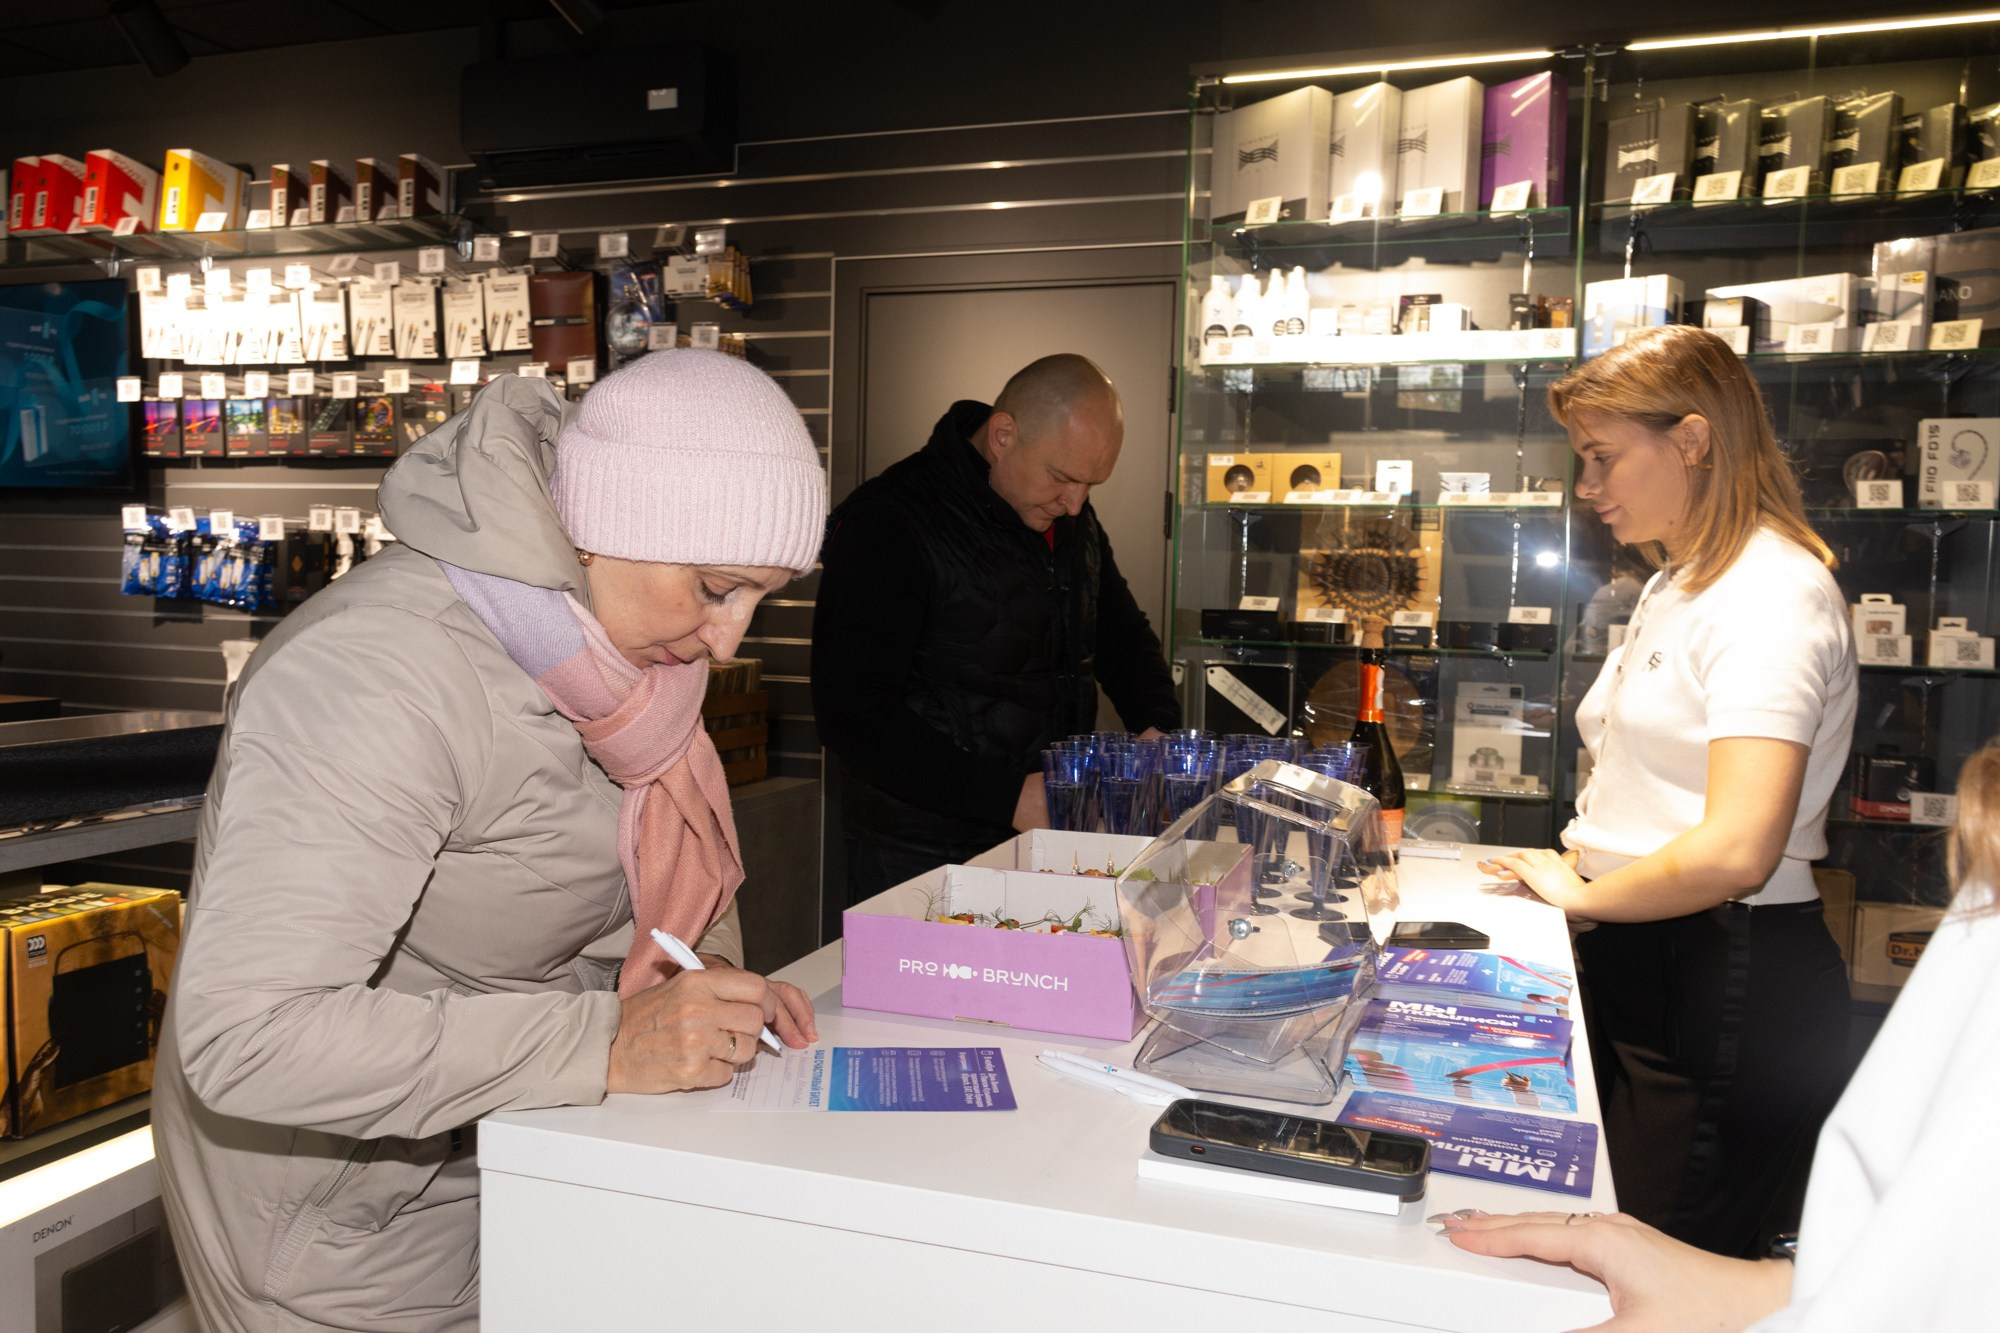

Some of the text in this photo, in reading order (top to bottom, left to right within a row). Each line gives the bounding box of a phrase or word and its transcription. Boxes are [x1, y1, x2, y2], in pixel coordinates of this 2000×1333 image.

[0, 892, 104, 915] BIGGIE
[899, 958, 1068, 992] PRO BRUNCH
[1386, 1007, 1519, 1028] ОТКРЫЛИСЬ!
[1388, 1000, 1457, 1016] МЫ
[809, 1050, 825, 1107] ВАШ СЧАСТЛИВЫЙ БИЛЕТ
[1451, 1136, 1528, 1153] Расписание
[1471, 1136, 1518, 1148] ноября
[1458, 1153, 1552, 1182] МЫ
[32, 1216, 72, 1243] DENON
